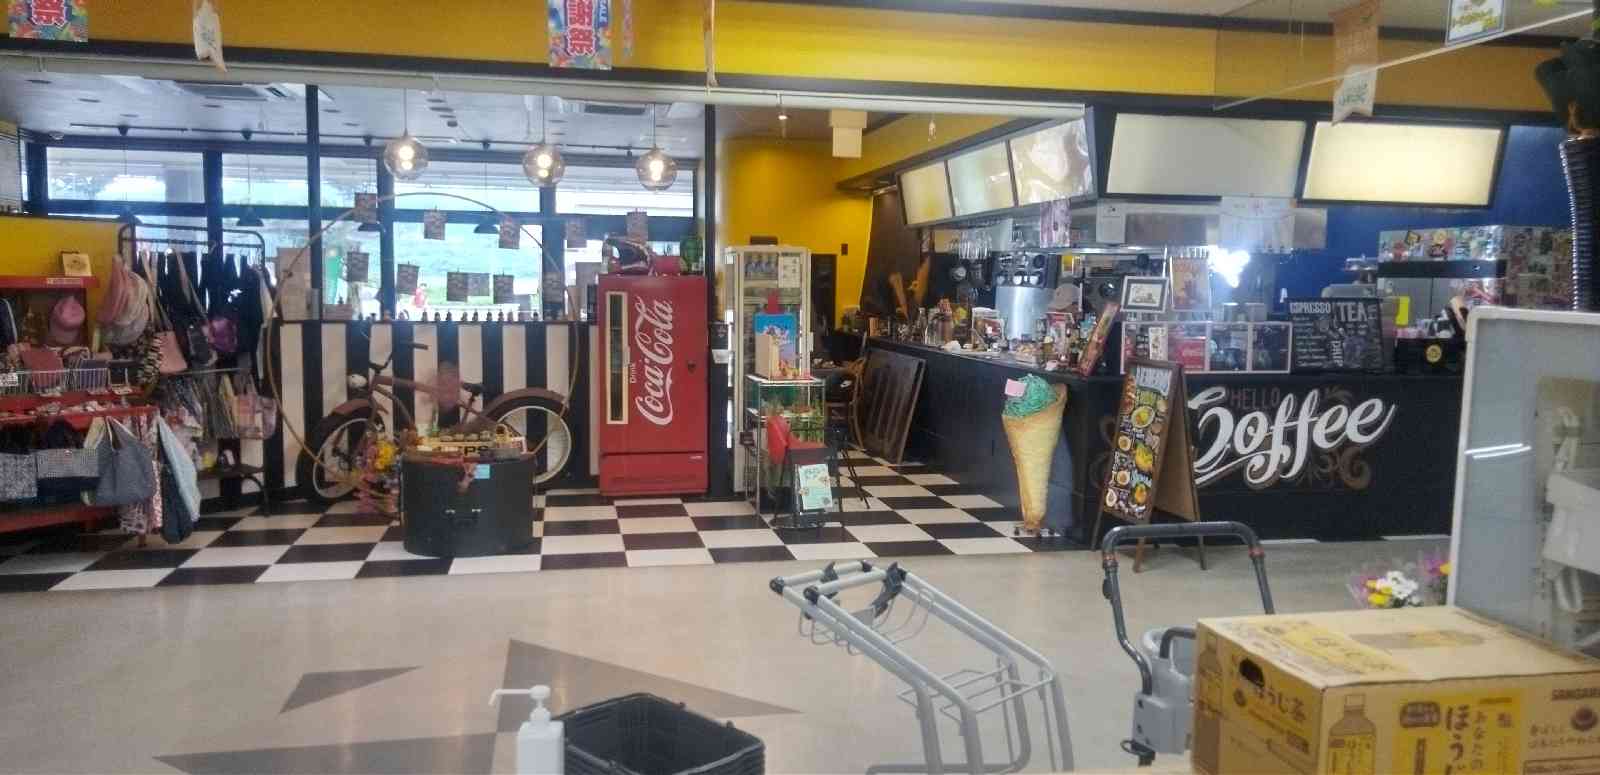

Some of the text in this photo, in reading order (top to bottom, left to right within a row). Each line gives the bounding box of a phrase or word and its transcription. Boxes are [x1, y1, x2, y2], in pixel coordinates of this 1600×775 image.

[1289, 301, 1331, 314] ESPRESSO
[1336, 302, 1368, 322] TEA
[1229, 387, 1281, 409] HELLO
[1188, 384, 1395, 485] Coffee
